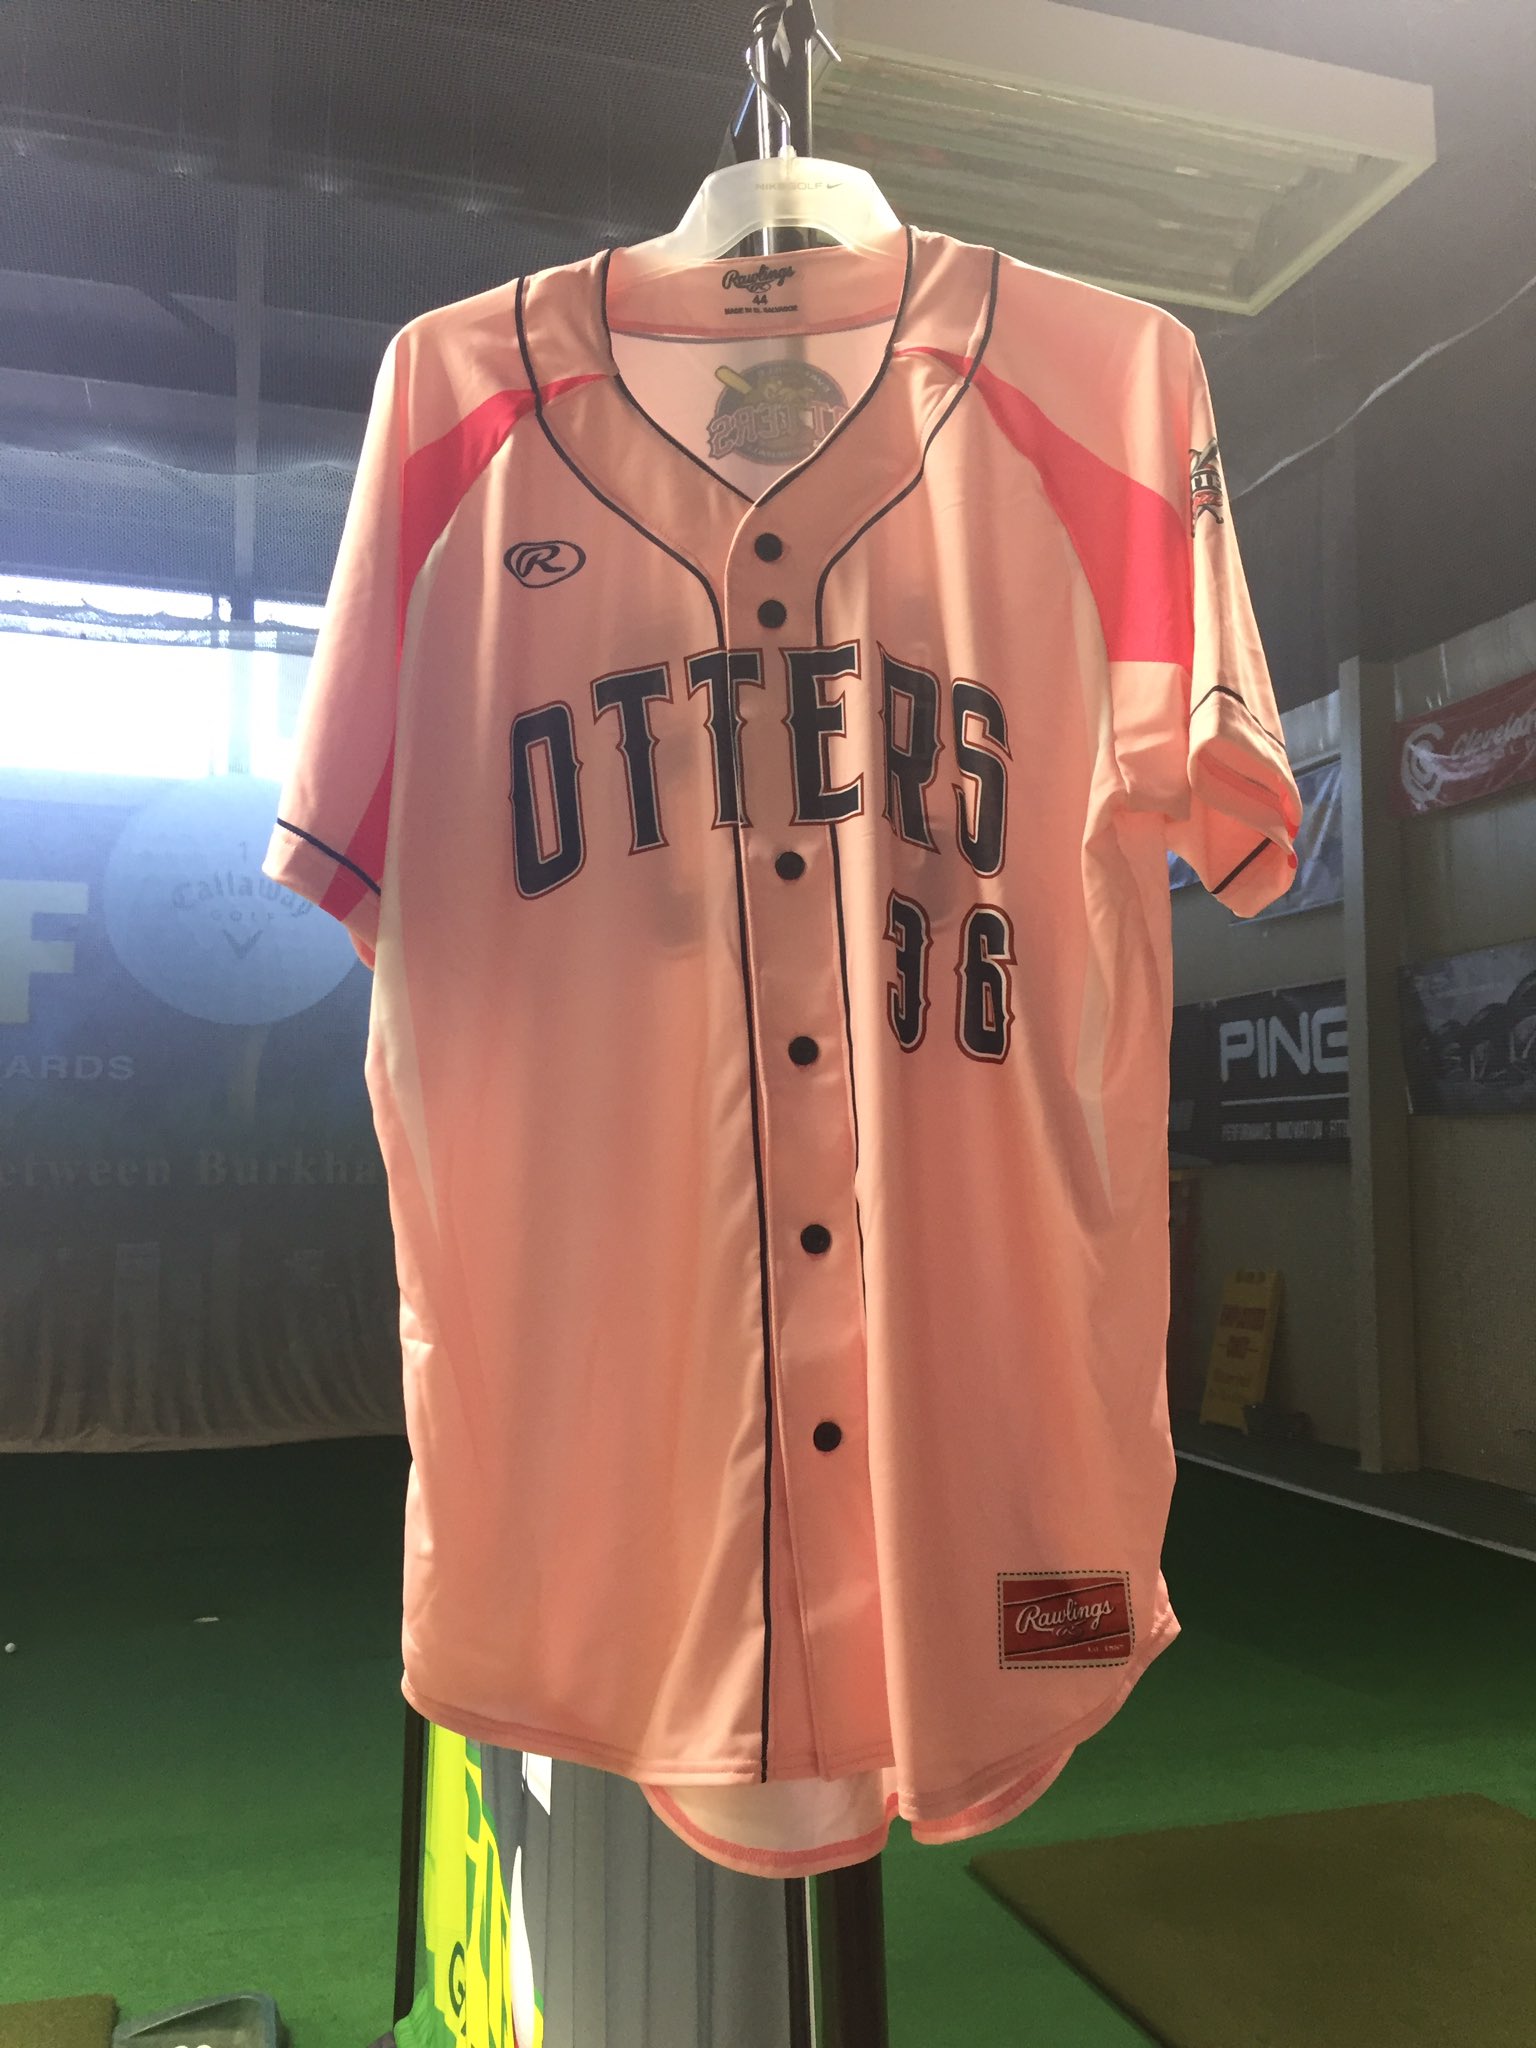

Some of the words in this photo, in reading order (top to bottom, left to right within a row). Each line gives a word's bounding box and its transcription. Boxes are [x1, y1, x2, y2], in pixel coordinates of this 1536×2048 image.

[790, 181, 824, 191] GOLF
[721, 264, 796, 290] Rawlings
[752, 294, 768, 305] 44
[508, 638, 1015, 901] OTTERS
[882, 888, 1019, 1065] 36
[1015, 1597, 1115, 1635] Rawlings
